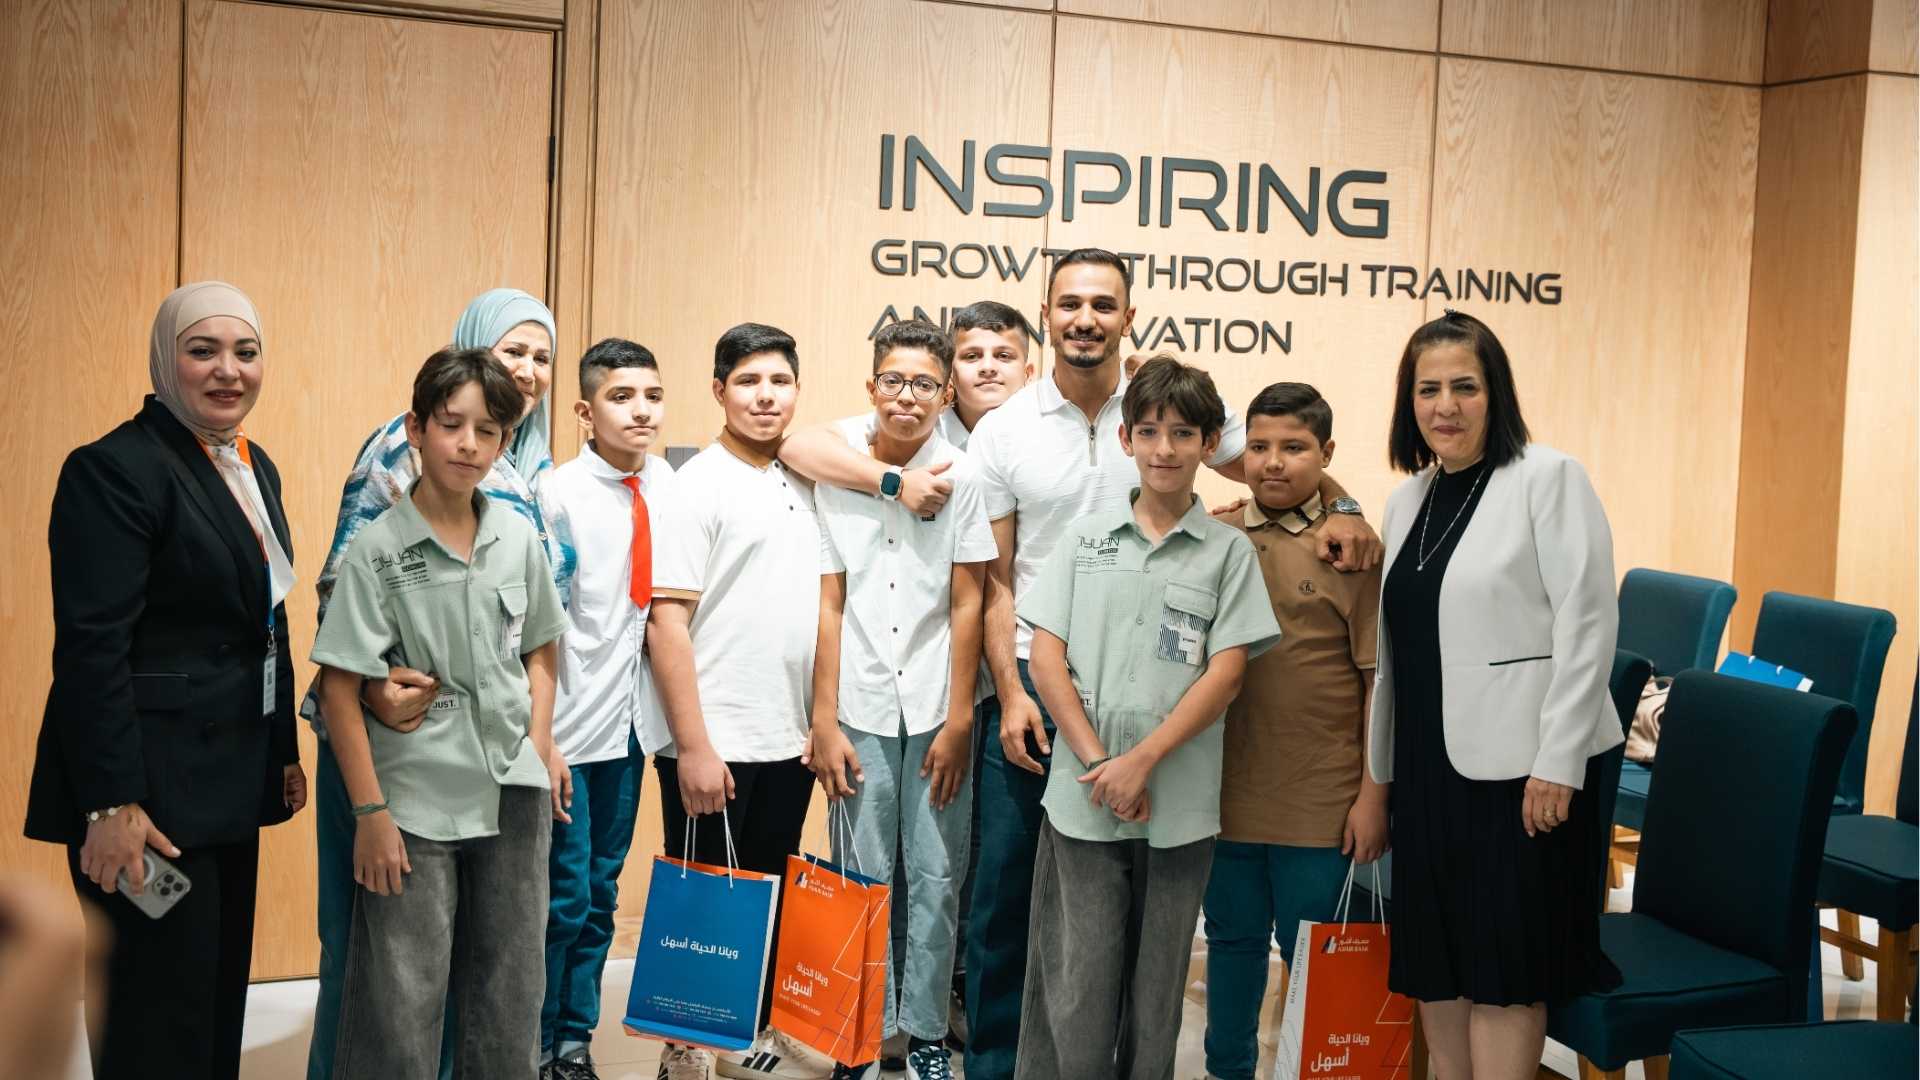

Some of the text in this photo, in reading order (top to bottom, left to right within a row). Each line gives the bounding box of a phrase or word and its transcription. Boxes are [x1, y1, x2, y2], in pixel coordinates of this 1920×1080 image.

[880, 133, 1390, 239] INSPIRING
[871, 239, 1562, 306] GROWT THROUGH TRAINING
[660, 935, 688, 949] أسهل
[690, 940, 716, 955] الحياة
[782, 974, 813, 998] أسهل
[1328, 1033, 1351, 1047] الحياة
[1311, 1046, 1350, 1072] أسهل
